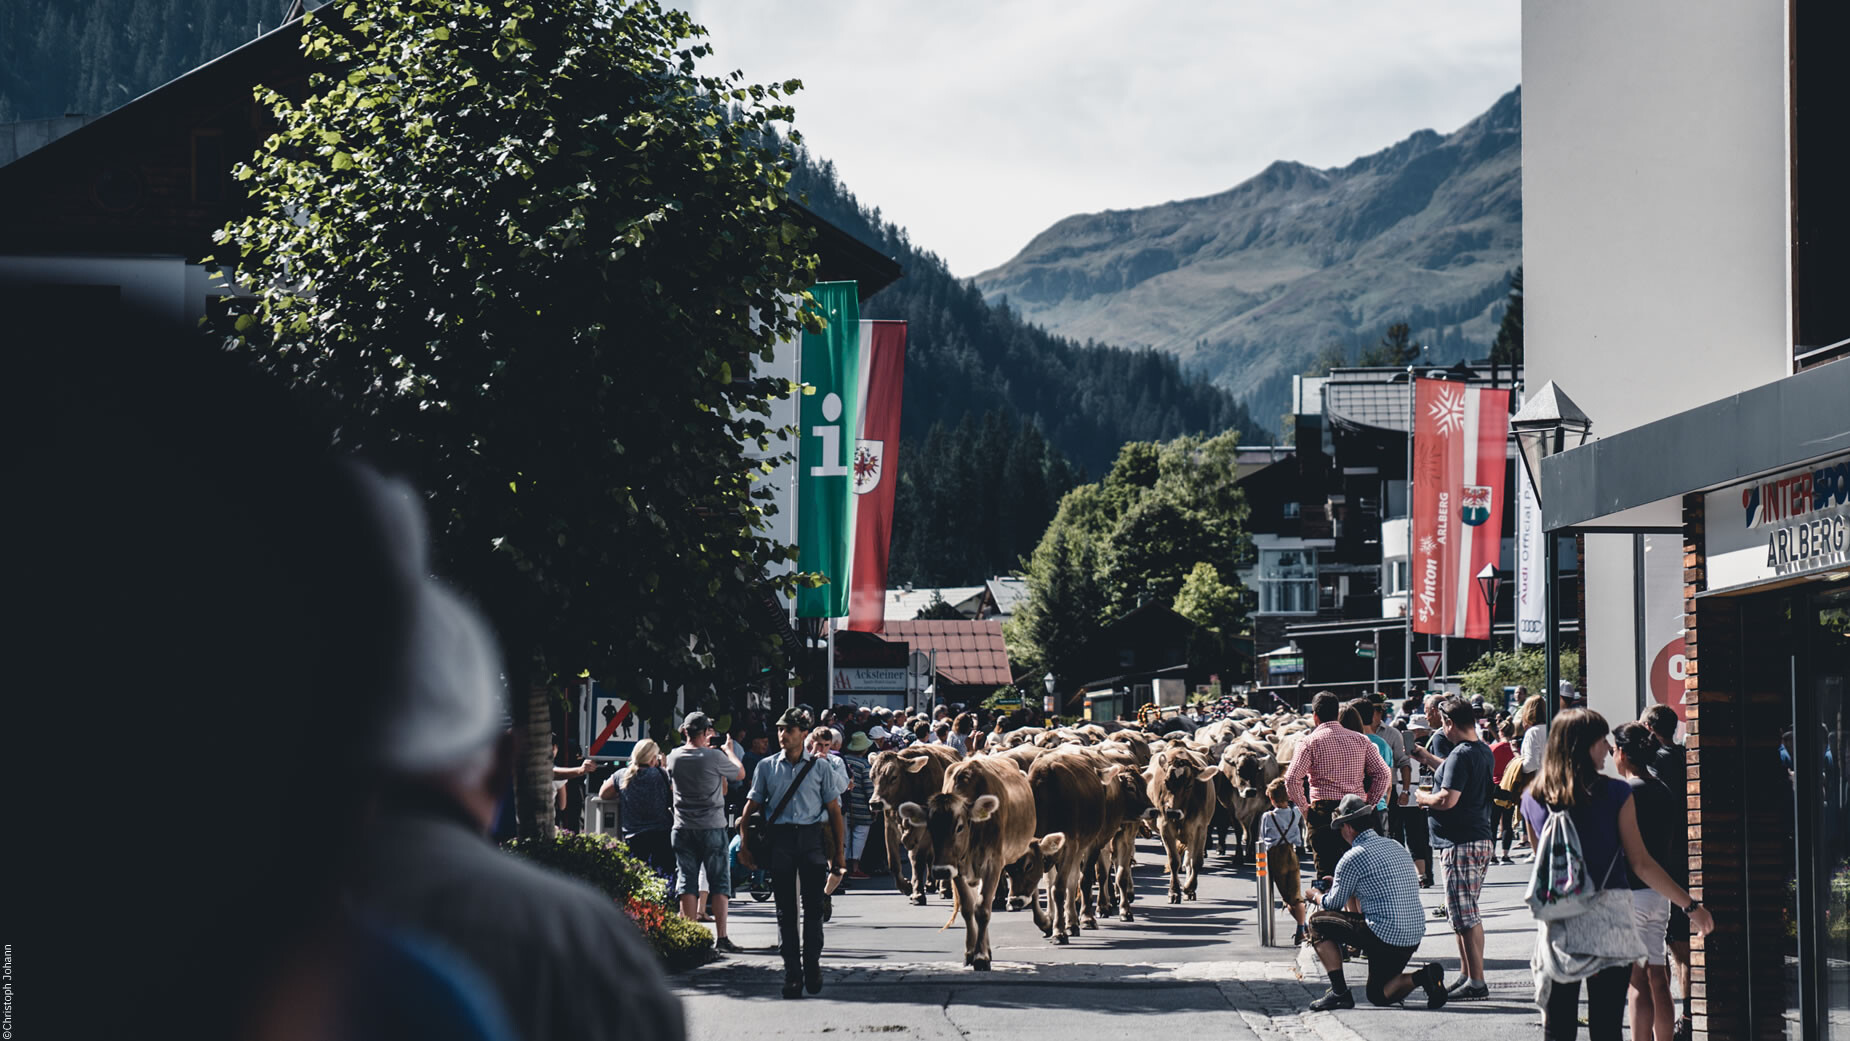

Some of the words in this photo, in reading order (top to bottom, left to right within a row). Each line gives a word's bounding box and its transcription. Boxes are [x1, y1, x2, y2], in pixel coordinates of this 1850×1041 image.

[1437, 492, 1449, 544] ARLBERG
[1762, 461, 1850, 524] INTERSPO
[1522, 506, 1531, 561] Official
[1767, 514, 1846, 567] ARLBERG
[1521, 567, 1529, 605] Audi
[854, 668, 904, 680] Acksteiner
